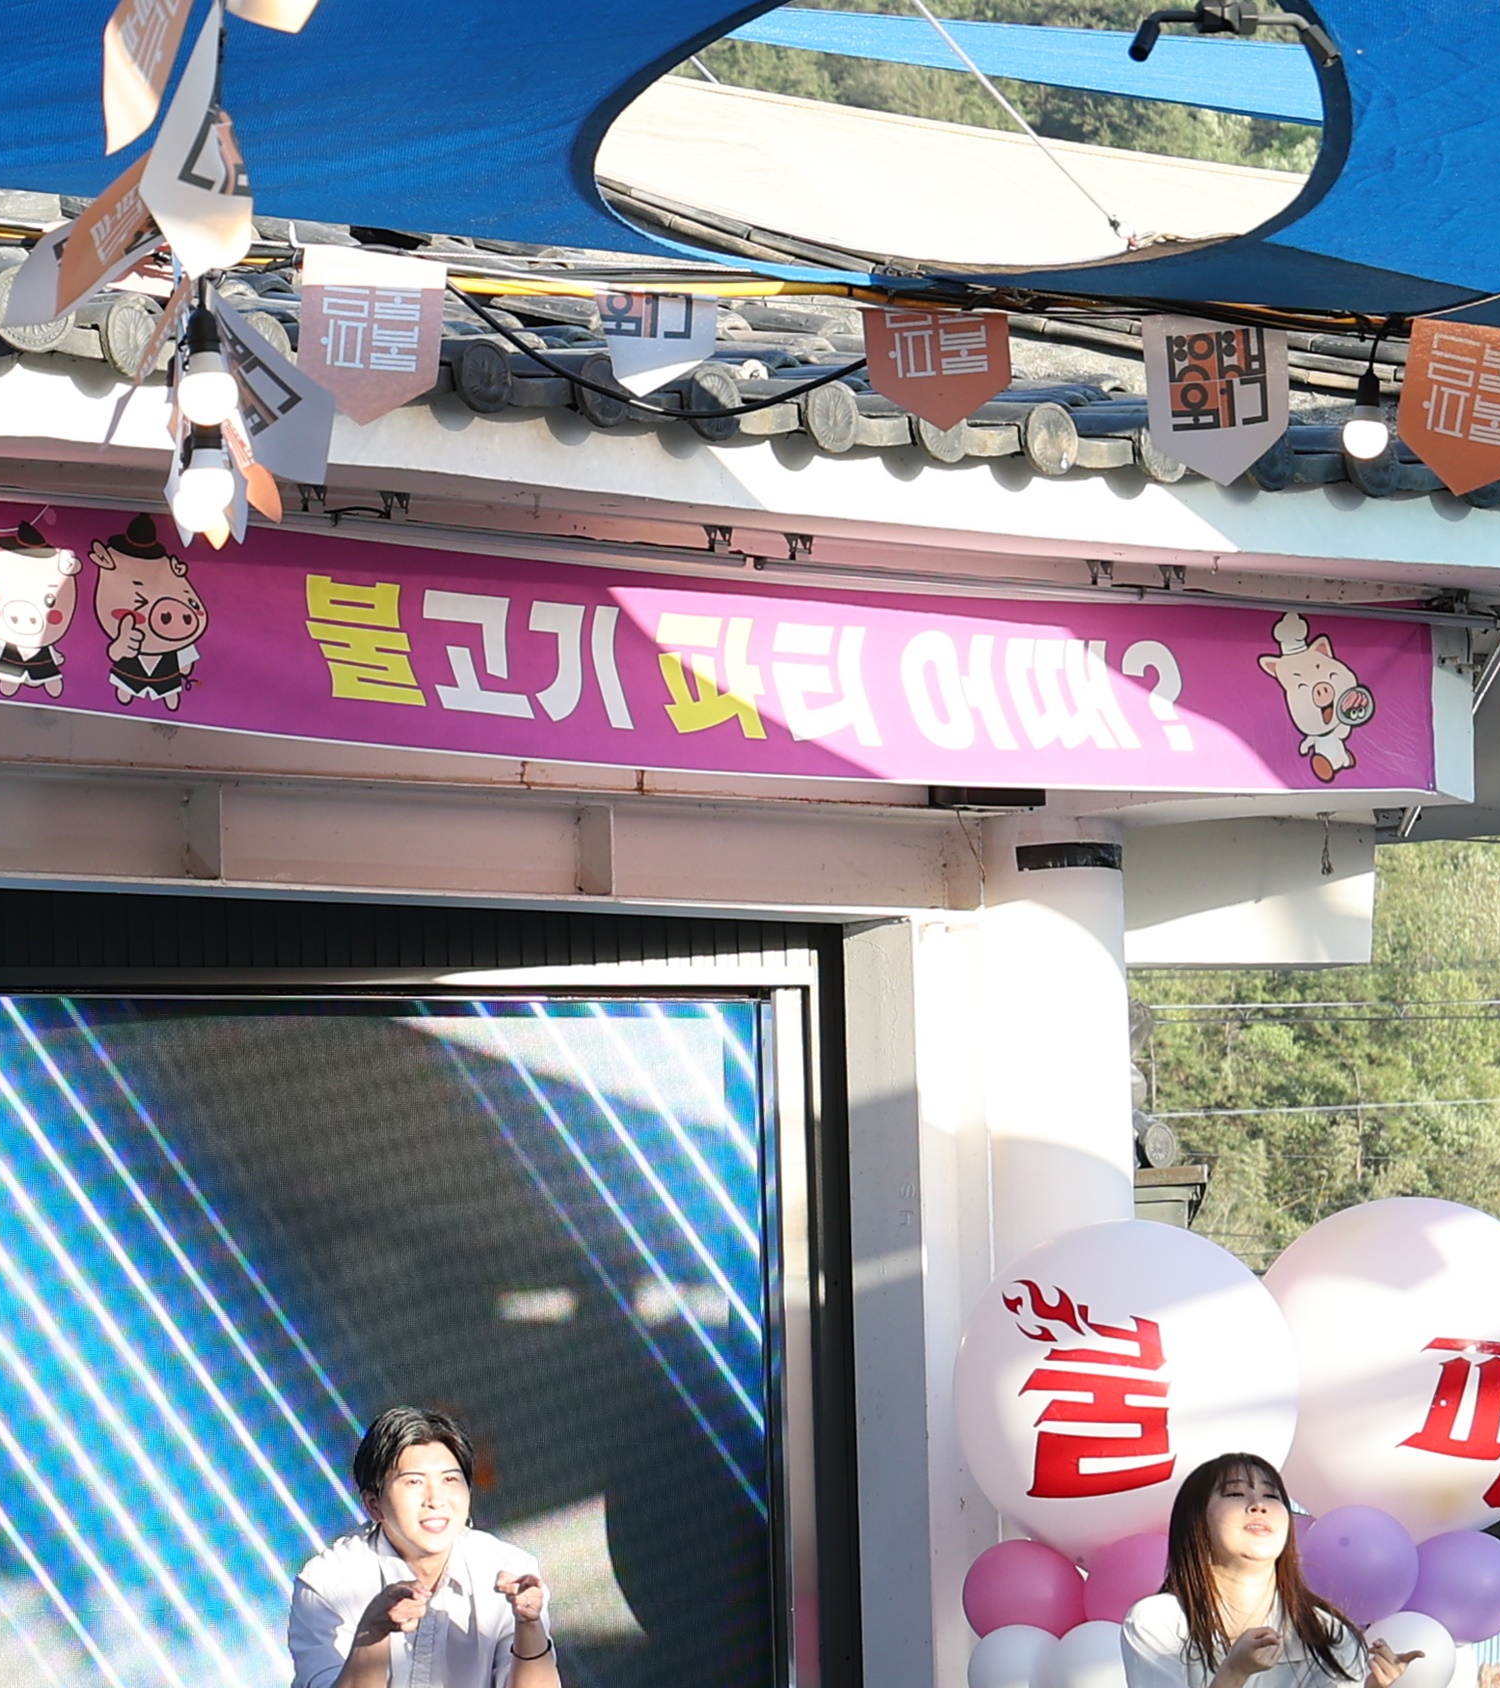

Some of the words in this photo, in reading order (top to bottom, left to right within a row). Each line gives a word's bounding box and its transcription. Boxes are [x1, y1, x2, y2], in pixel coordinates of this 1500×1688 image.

[305, 573, 635, 731] 불고기
[655, 611, 883, 746] 파티
[899, 629, 1195, 752] 어때?
[1003, 1279, 1177, 1499] 불
